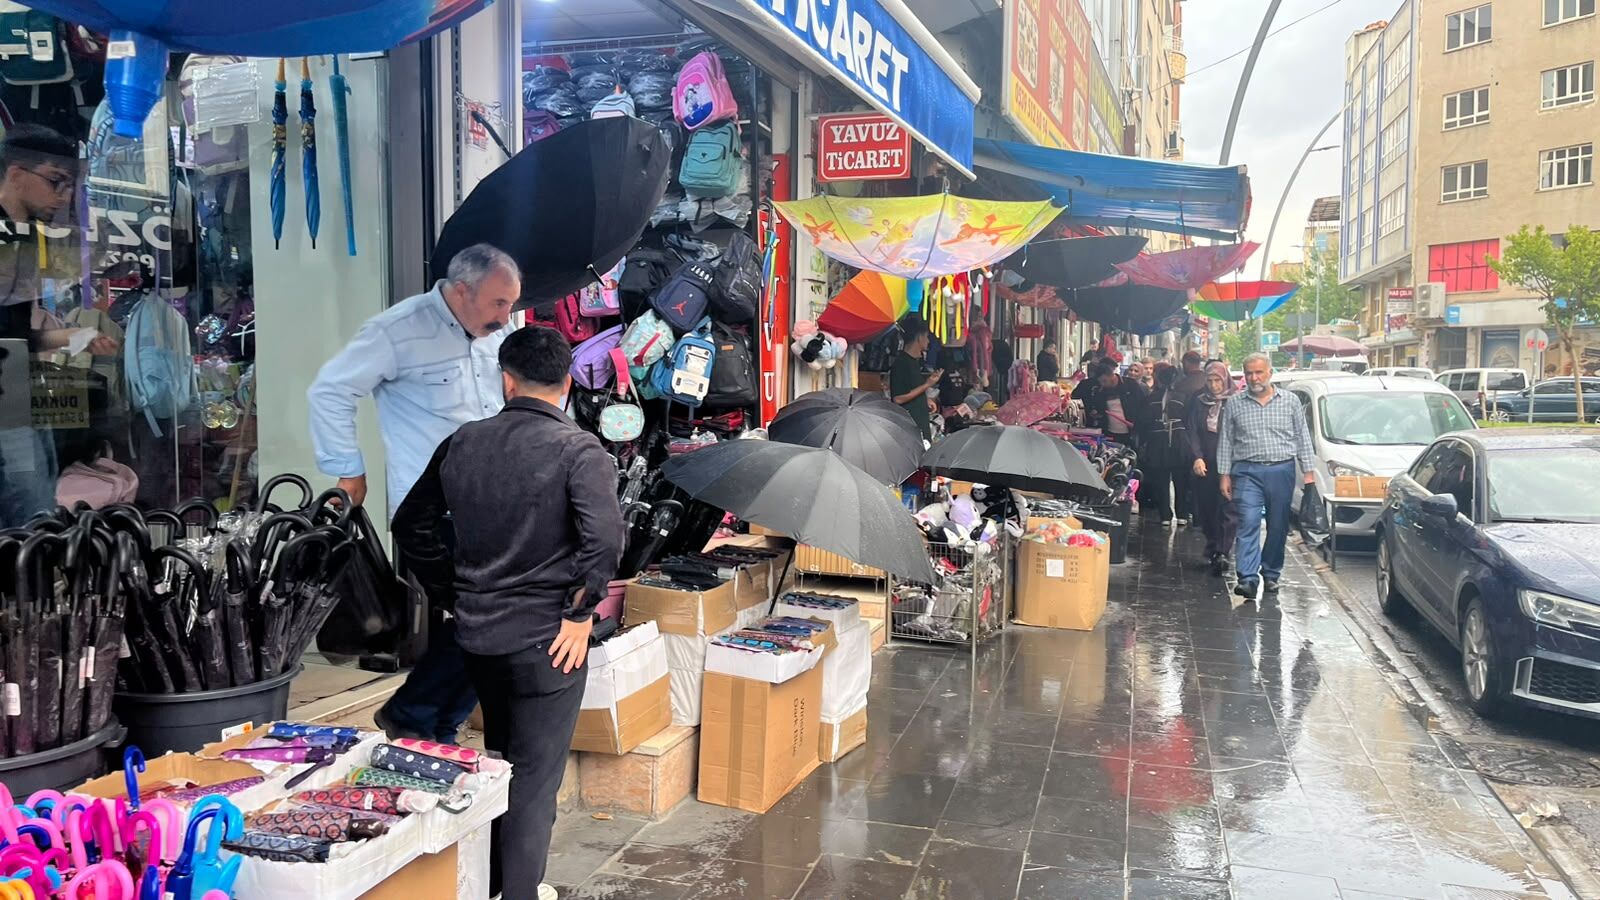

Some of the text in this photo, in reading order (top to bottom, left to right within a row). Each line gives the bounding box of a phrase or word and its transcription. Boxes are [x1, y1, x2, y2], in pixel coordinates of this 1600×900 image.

[772, 0, 909, 112] CARET
[830, 122, 900, 144] YAVUZ
[826, 149, 903, 171] TiCARET
